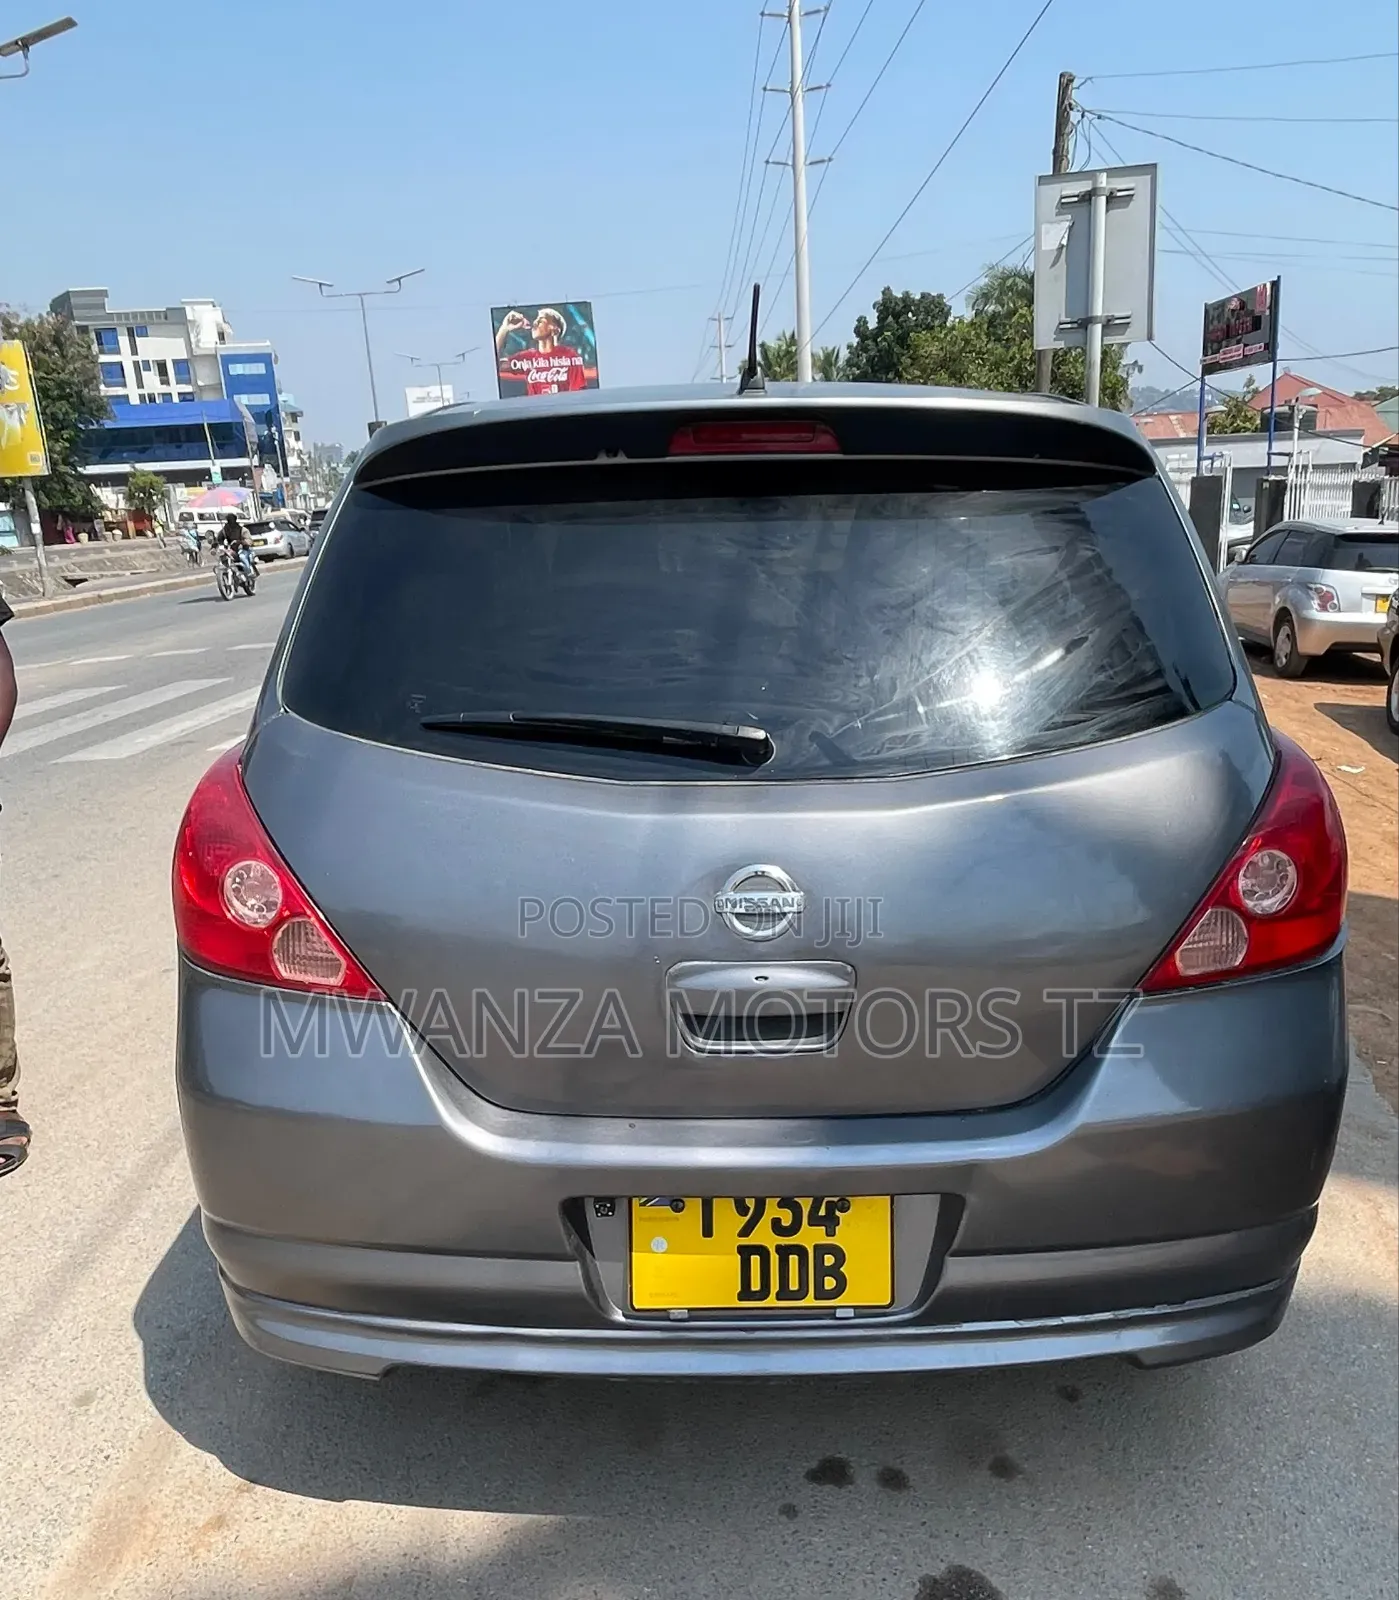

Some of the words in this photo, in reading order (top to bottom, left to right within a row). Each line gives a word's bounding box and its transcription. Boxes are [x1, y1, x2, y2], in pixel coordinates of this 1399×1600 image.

[511, 359, 532, 371] Onja
[572, 356, 583, 366] na
[726, 897, 795, 909] NISSAN
[734, 1197, 840, 1238] 934
[736, 1243, 848, 1302] DDB
